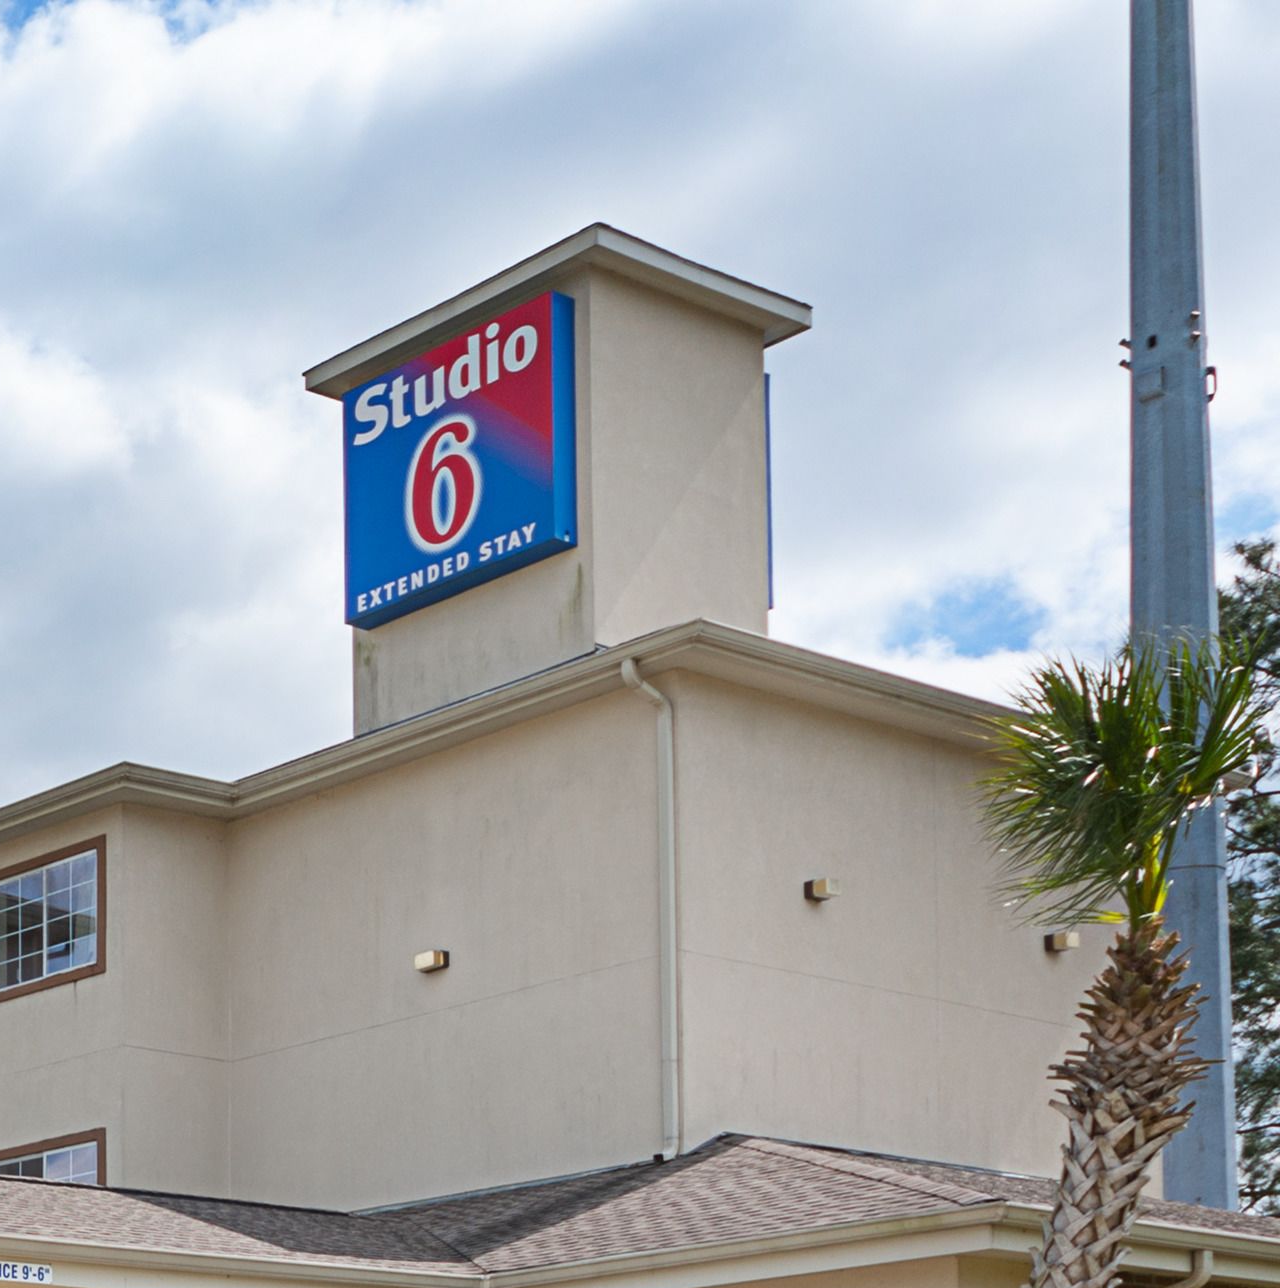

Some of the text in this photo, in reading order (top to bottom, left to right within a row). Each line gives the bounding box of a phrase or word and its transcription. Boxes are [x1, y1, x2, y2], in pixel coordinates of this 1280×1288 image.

[352, 322, 539, 446] Studio
[410, 420, 476, 547] 6
[356, 521, 537, 613] EXTENDED STAY
[22, 1264, 51, 1282] 9'-6"
